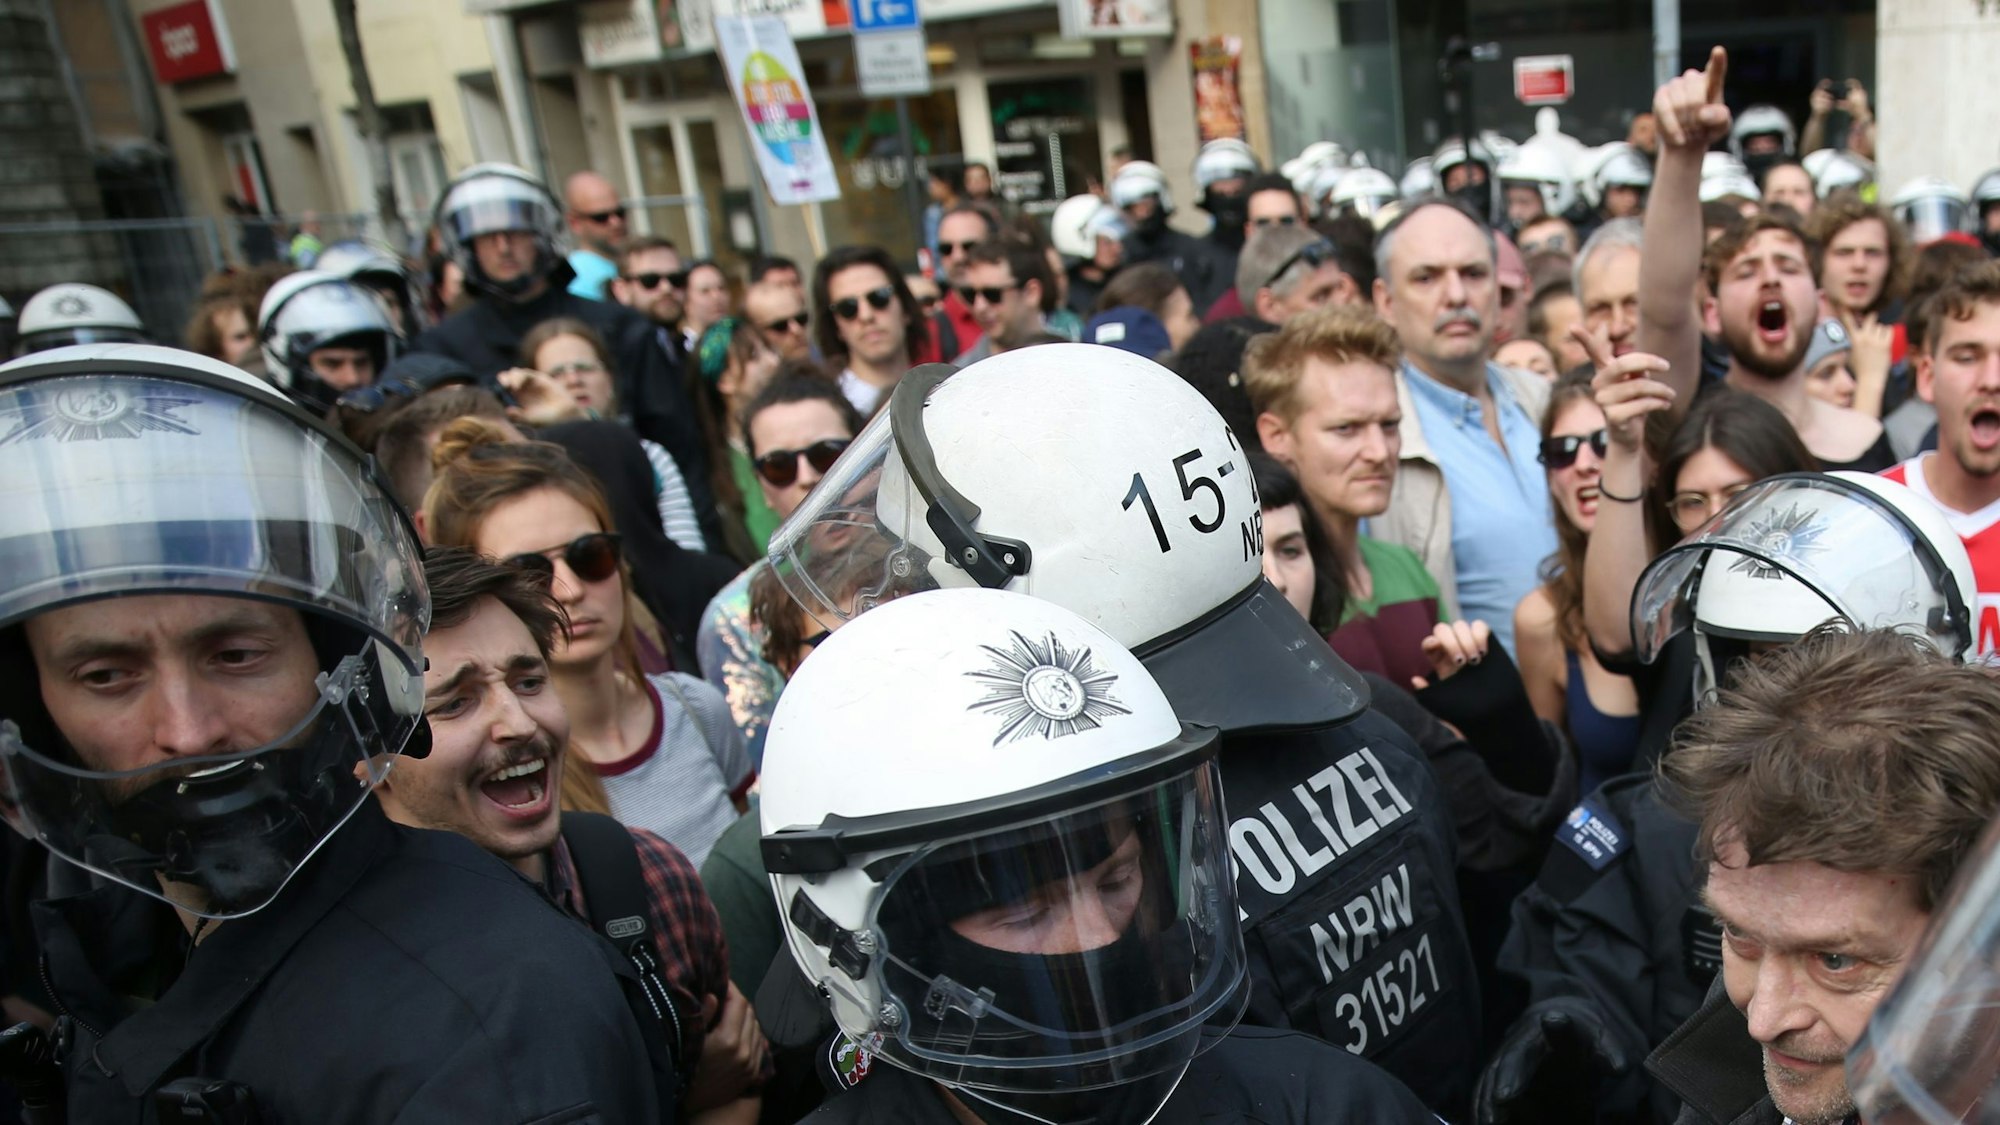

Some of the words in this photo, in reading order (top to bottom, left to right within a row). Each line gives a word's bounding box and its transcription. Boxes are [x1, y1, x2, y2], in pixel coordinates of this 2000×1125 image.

[1228, 747, 1413, 922] OLIZEI
[1309, 863, 1414, 985] NRW
[1335, 932, 1440, 1056] 31521
